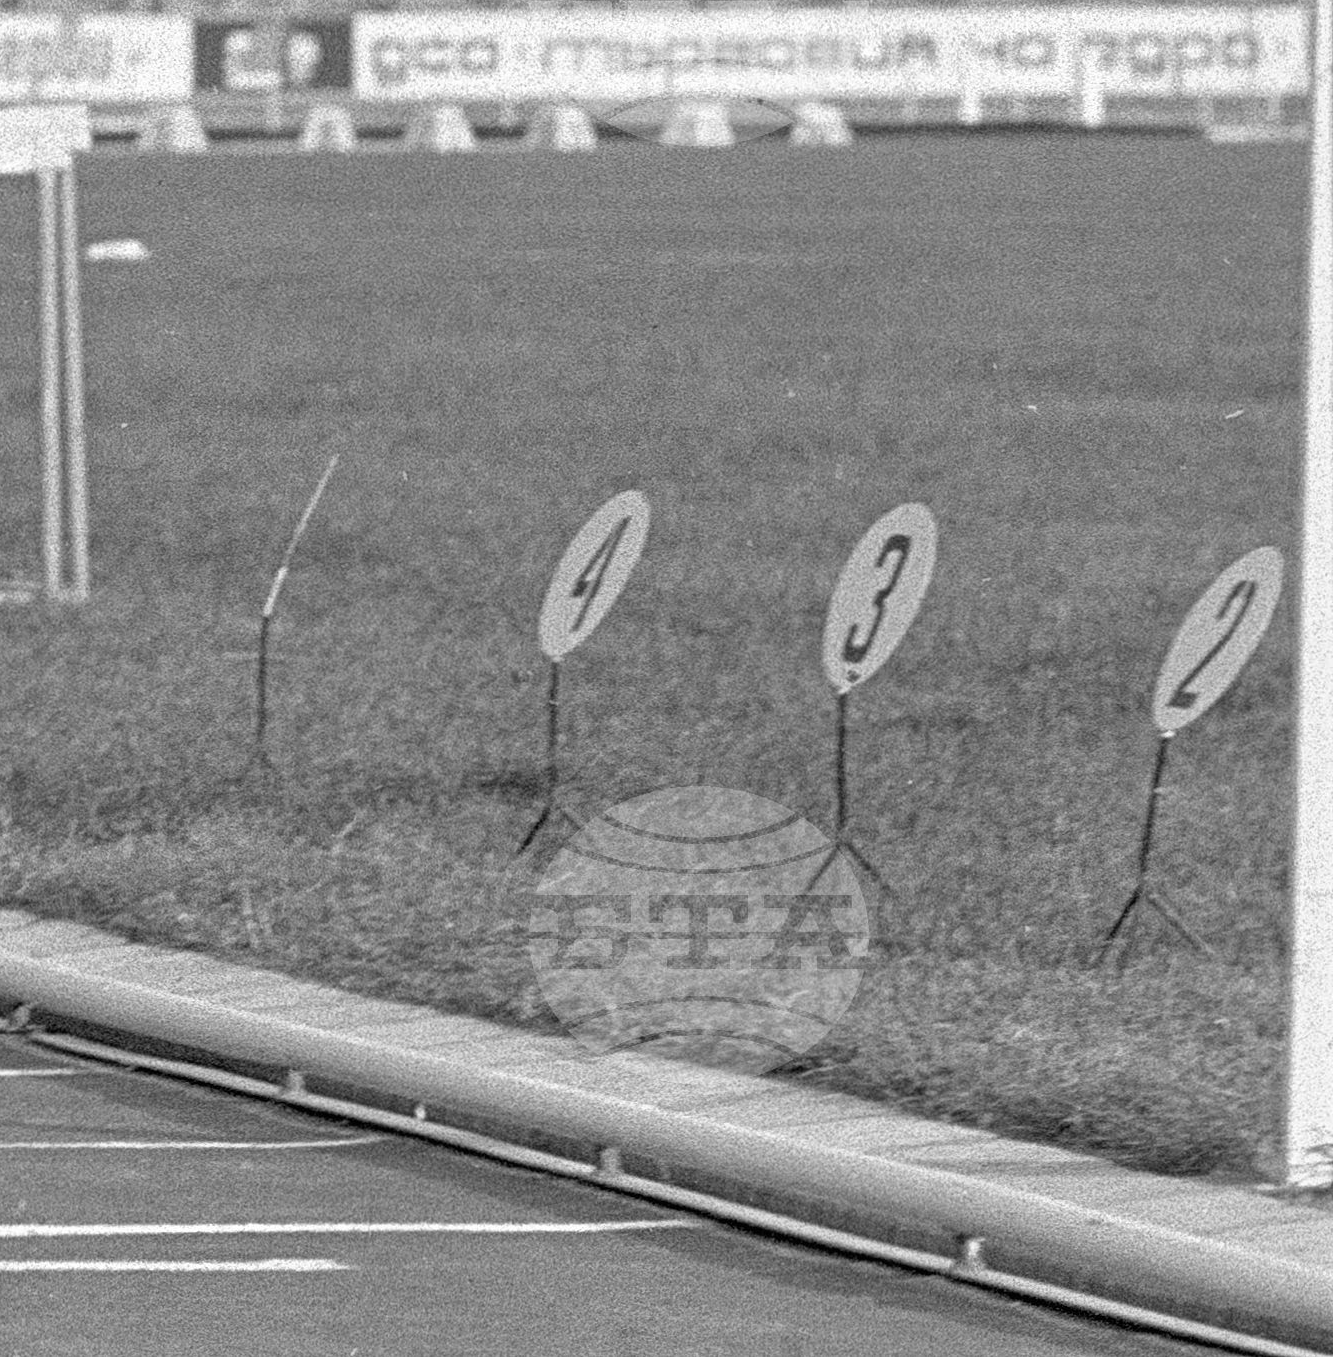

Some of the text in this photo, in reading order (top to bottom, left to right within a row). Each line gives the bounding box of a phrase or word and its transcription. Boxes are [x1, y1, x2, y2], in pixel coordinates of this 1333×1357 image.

[571, 515, 633, 632] 4
[842, 533, 912, 664] 3
[1165, 578, 1258, 709] 2
